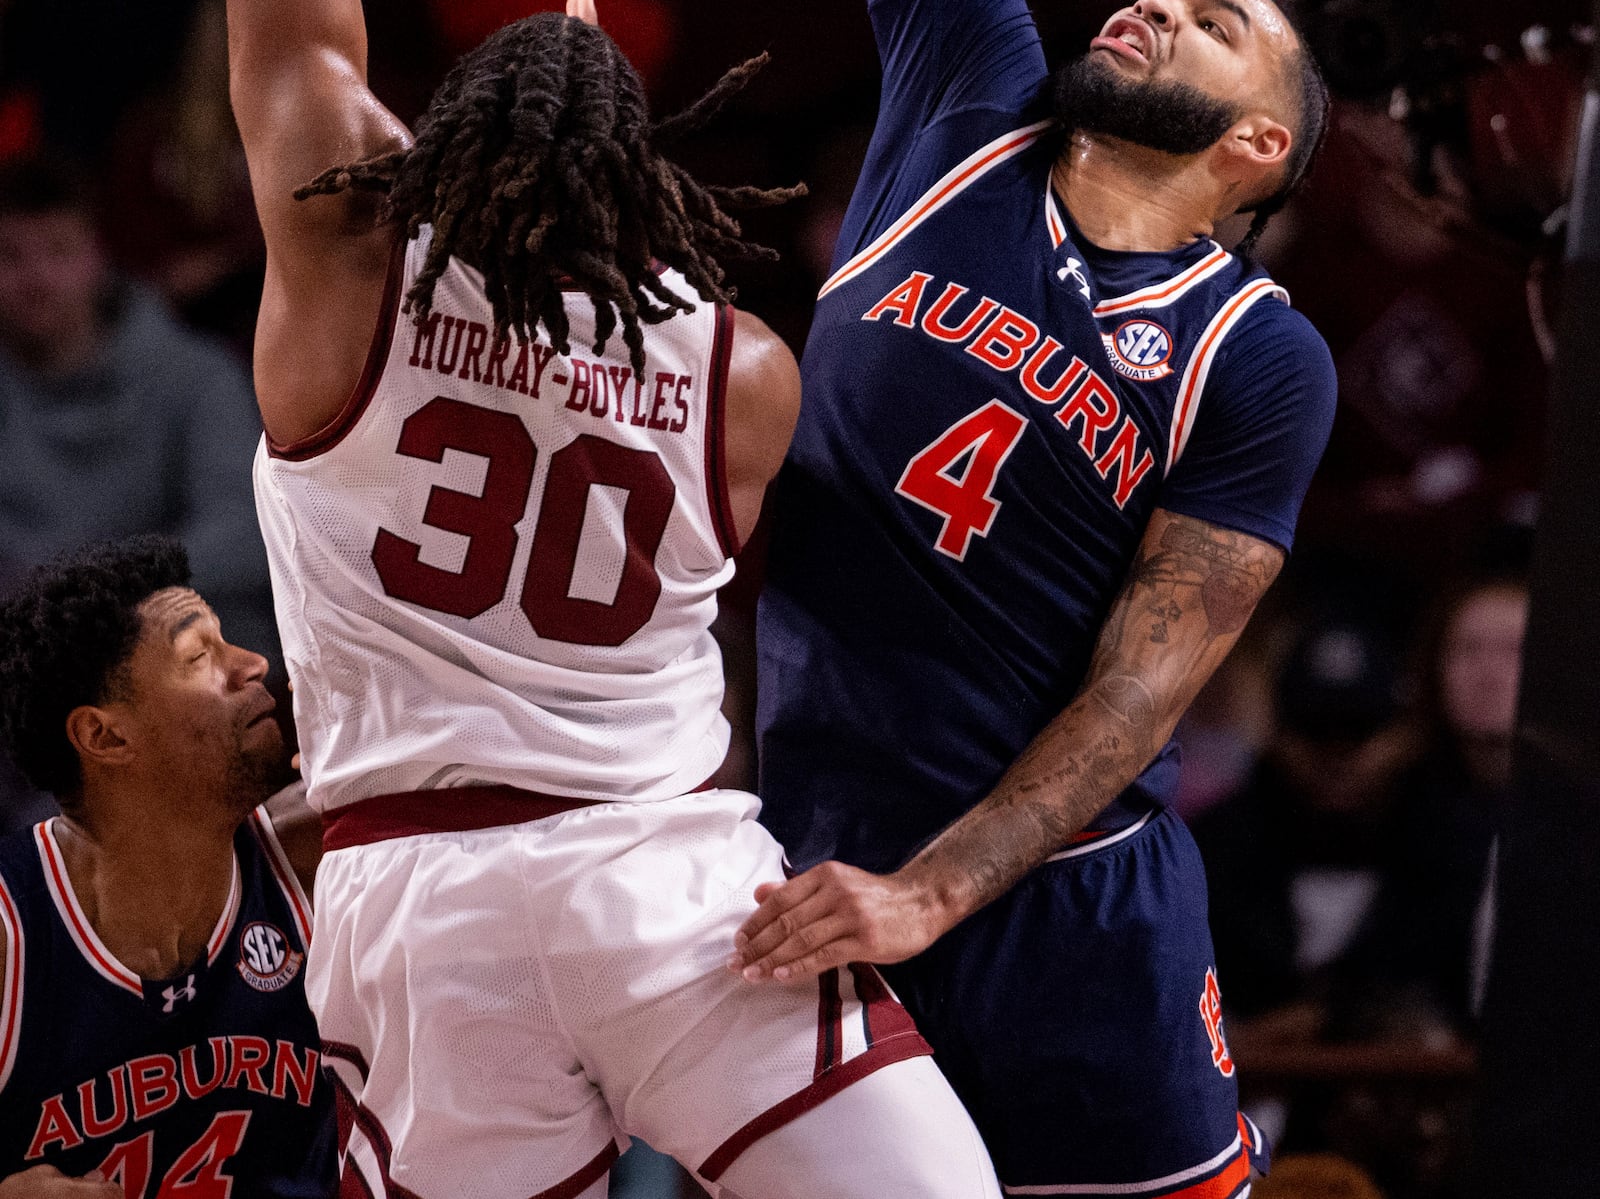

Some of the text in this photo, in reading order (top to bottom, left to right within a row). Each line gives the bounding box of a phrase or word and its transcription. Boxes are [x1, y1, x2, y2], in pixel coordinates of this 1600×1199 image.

[409, 311, 692, 433] MURRAY-BOYLES
[861, 270, 1154, 511] AUBURN
[1103, 345, 1157, 380] GRADUATE
[1118, 323, 1169, 366] SEC
[371, 395, 676, 647] 30
[894, 397, 1029, 563] 4
[243, 925, 285, 974] SEC
[245, 965, 295, 990] GRADUATE
[24, 1035, 319, 1161] AUBURN
